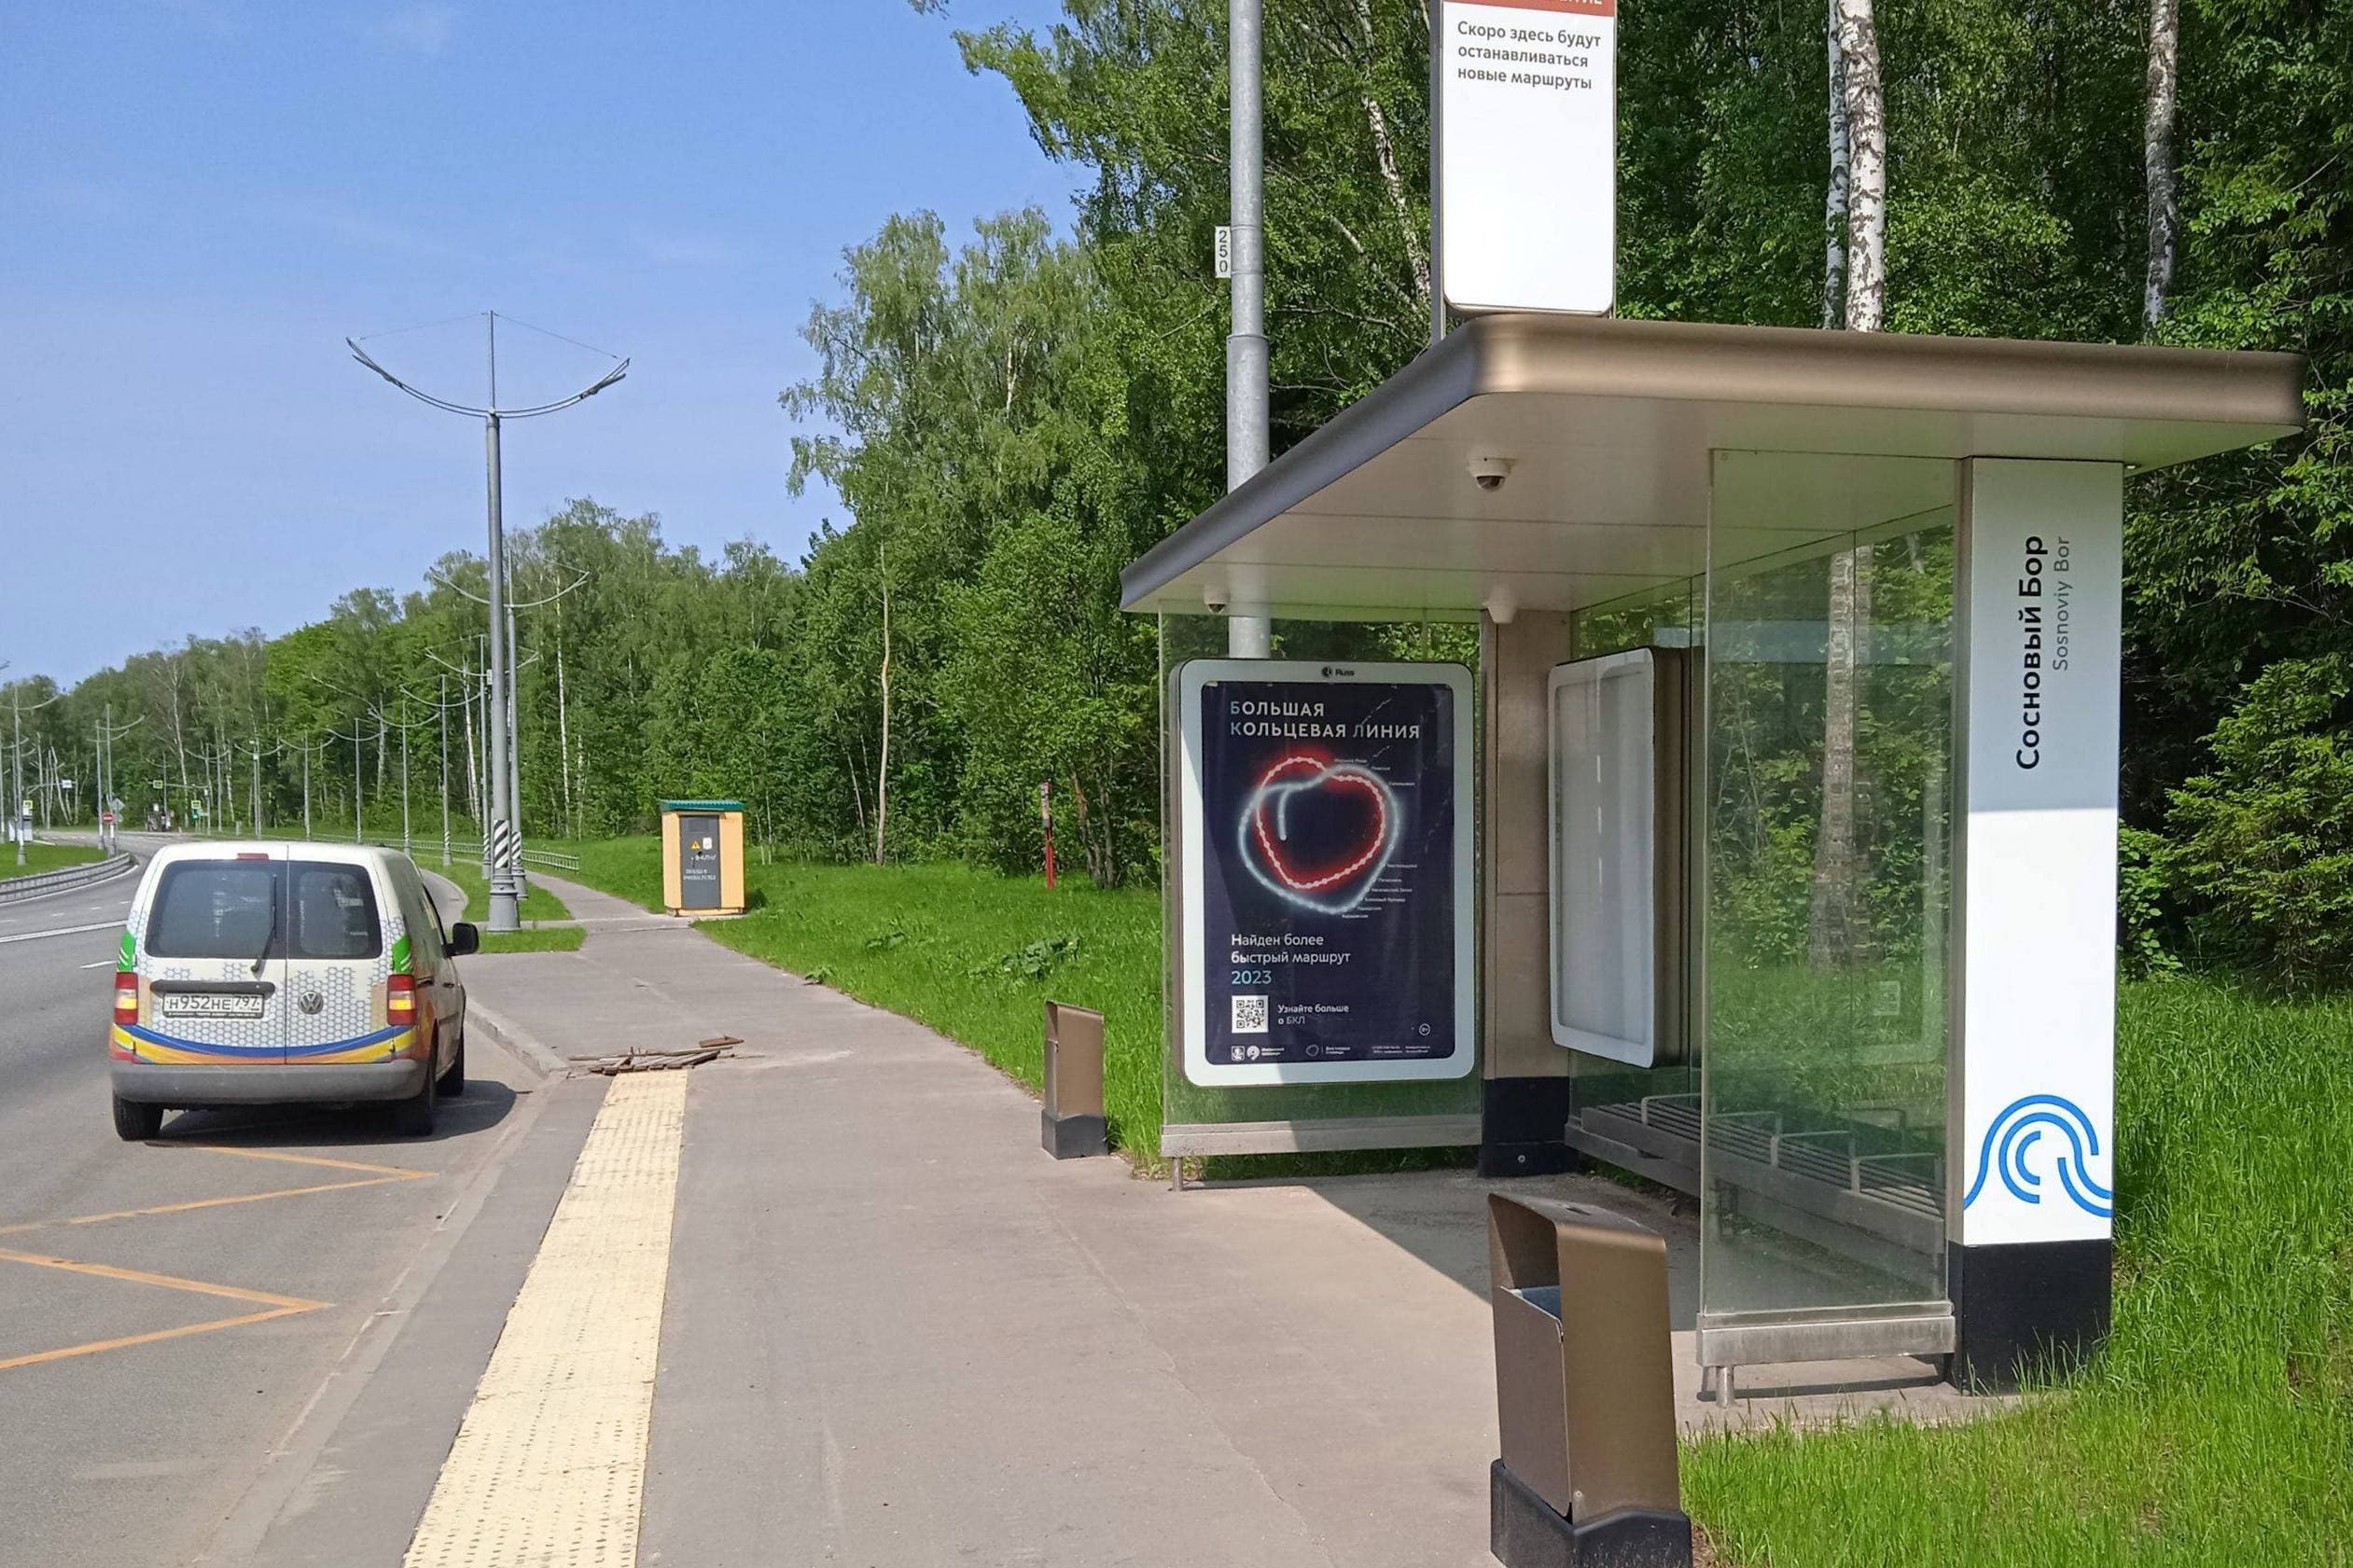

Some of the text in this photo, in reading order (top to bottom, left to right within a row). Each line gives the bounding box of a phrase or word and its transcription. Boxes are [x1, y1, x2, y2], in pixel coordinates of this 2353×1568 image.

[1457, 21, 1601, 49] Скоро здесь будут
[1457, 46, 1588, 67] останавливаться
[1457, 67, 1592, 90] новые маршруты
[1218, 229, 1228, 272] 250
[2053, 536, 2073, 671] Sosnoviy Bor
[2016, 535, 2048, 770] Сосновый Бор
[1231, 701, 1324, 716] БОЛЬШАЯ
[1231, 722, 1419, 739] КОЛЬЦЕВАЯ ЛИНИЯ
[1232, 934, 1324, 947] Найден более
[1232, 951, 1350, 965] быстрый маршрут
[1232, 970, 1272, 984] 2023
[1278, 1004, 1349, 1013] Узнайте больше
[1287, 1016, 1305, 1024] БКЛ
